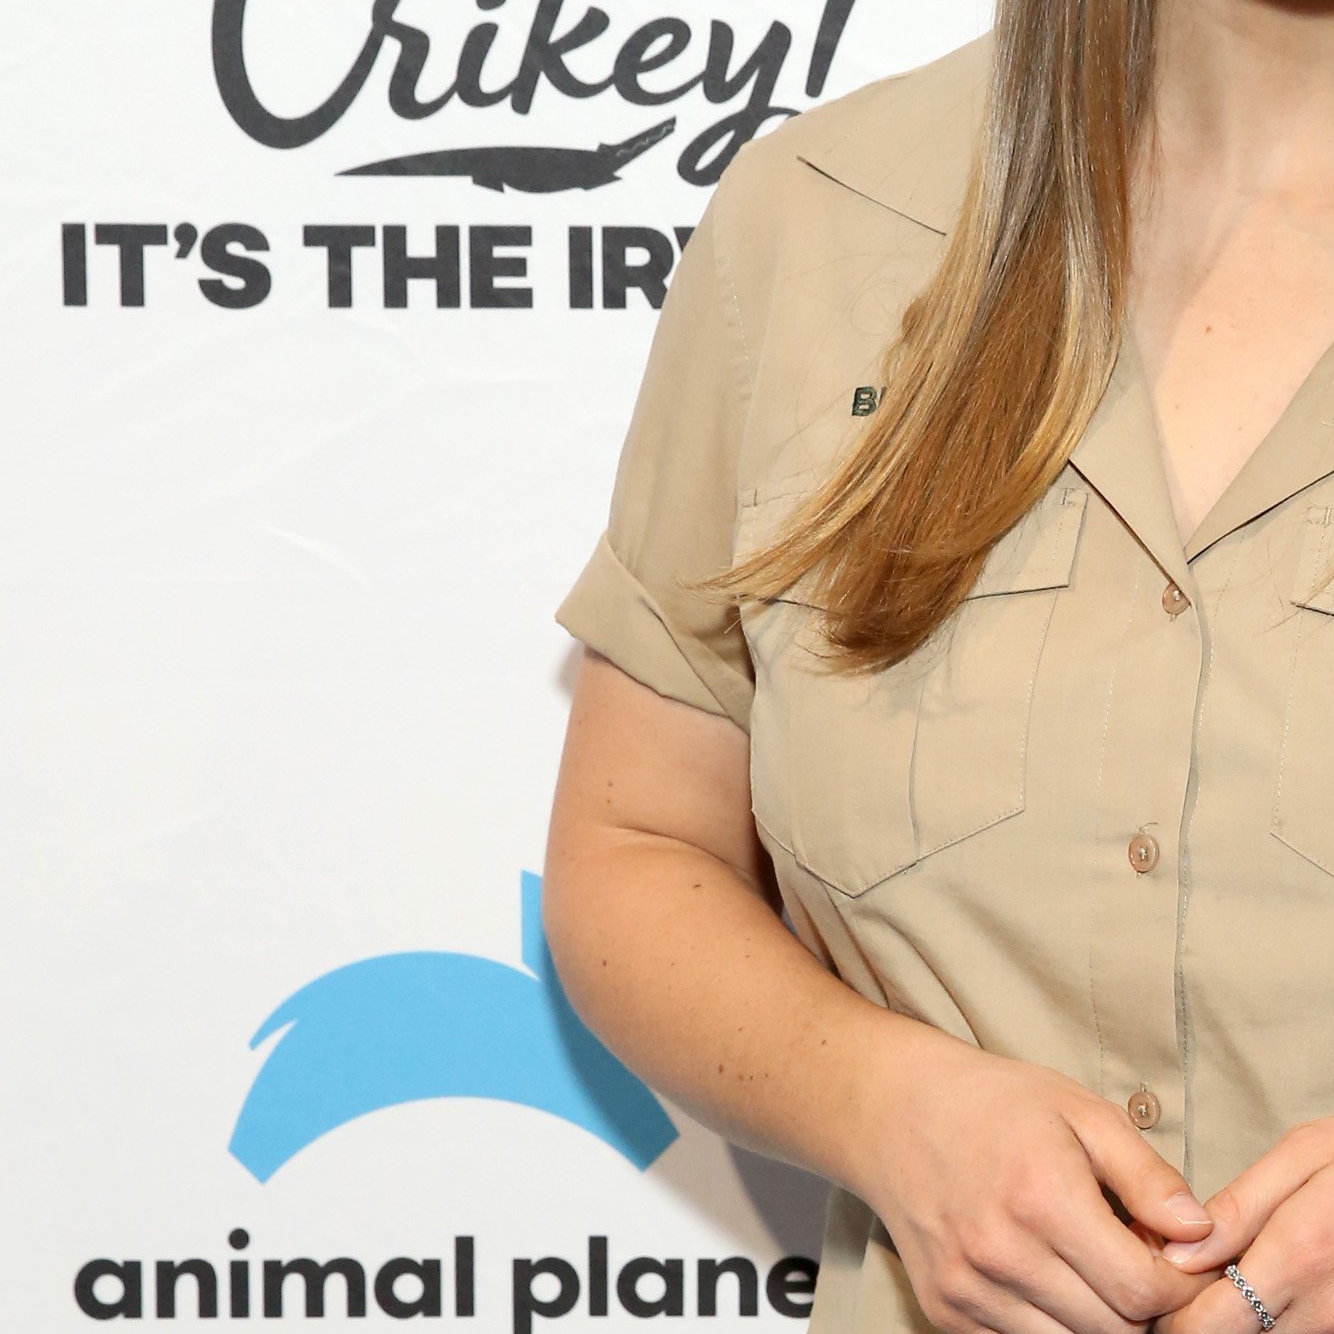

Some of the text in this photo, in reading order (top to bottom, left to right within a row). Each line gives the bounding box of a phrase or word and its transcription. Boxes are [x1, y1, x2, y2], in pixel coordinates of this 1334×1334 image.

[62, 222, 697, 310] IT'S THE IR
[74, 1228, 475, 1321] animal
